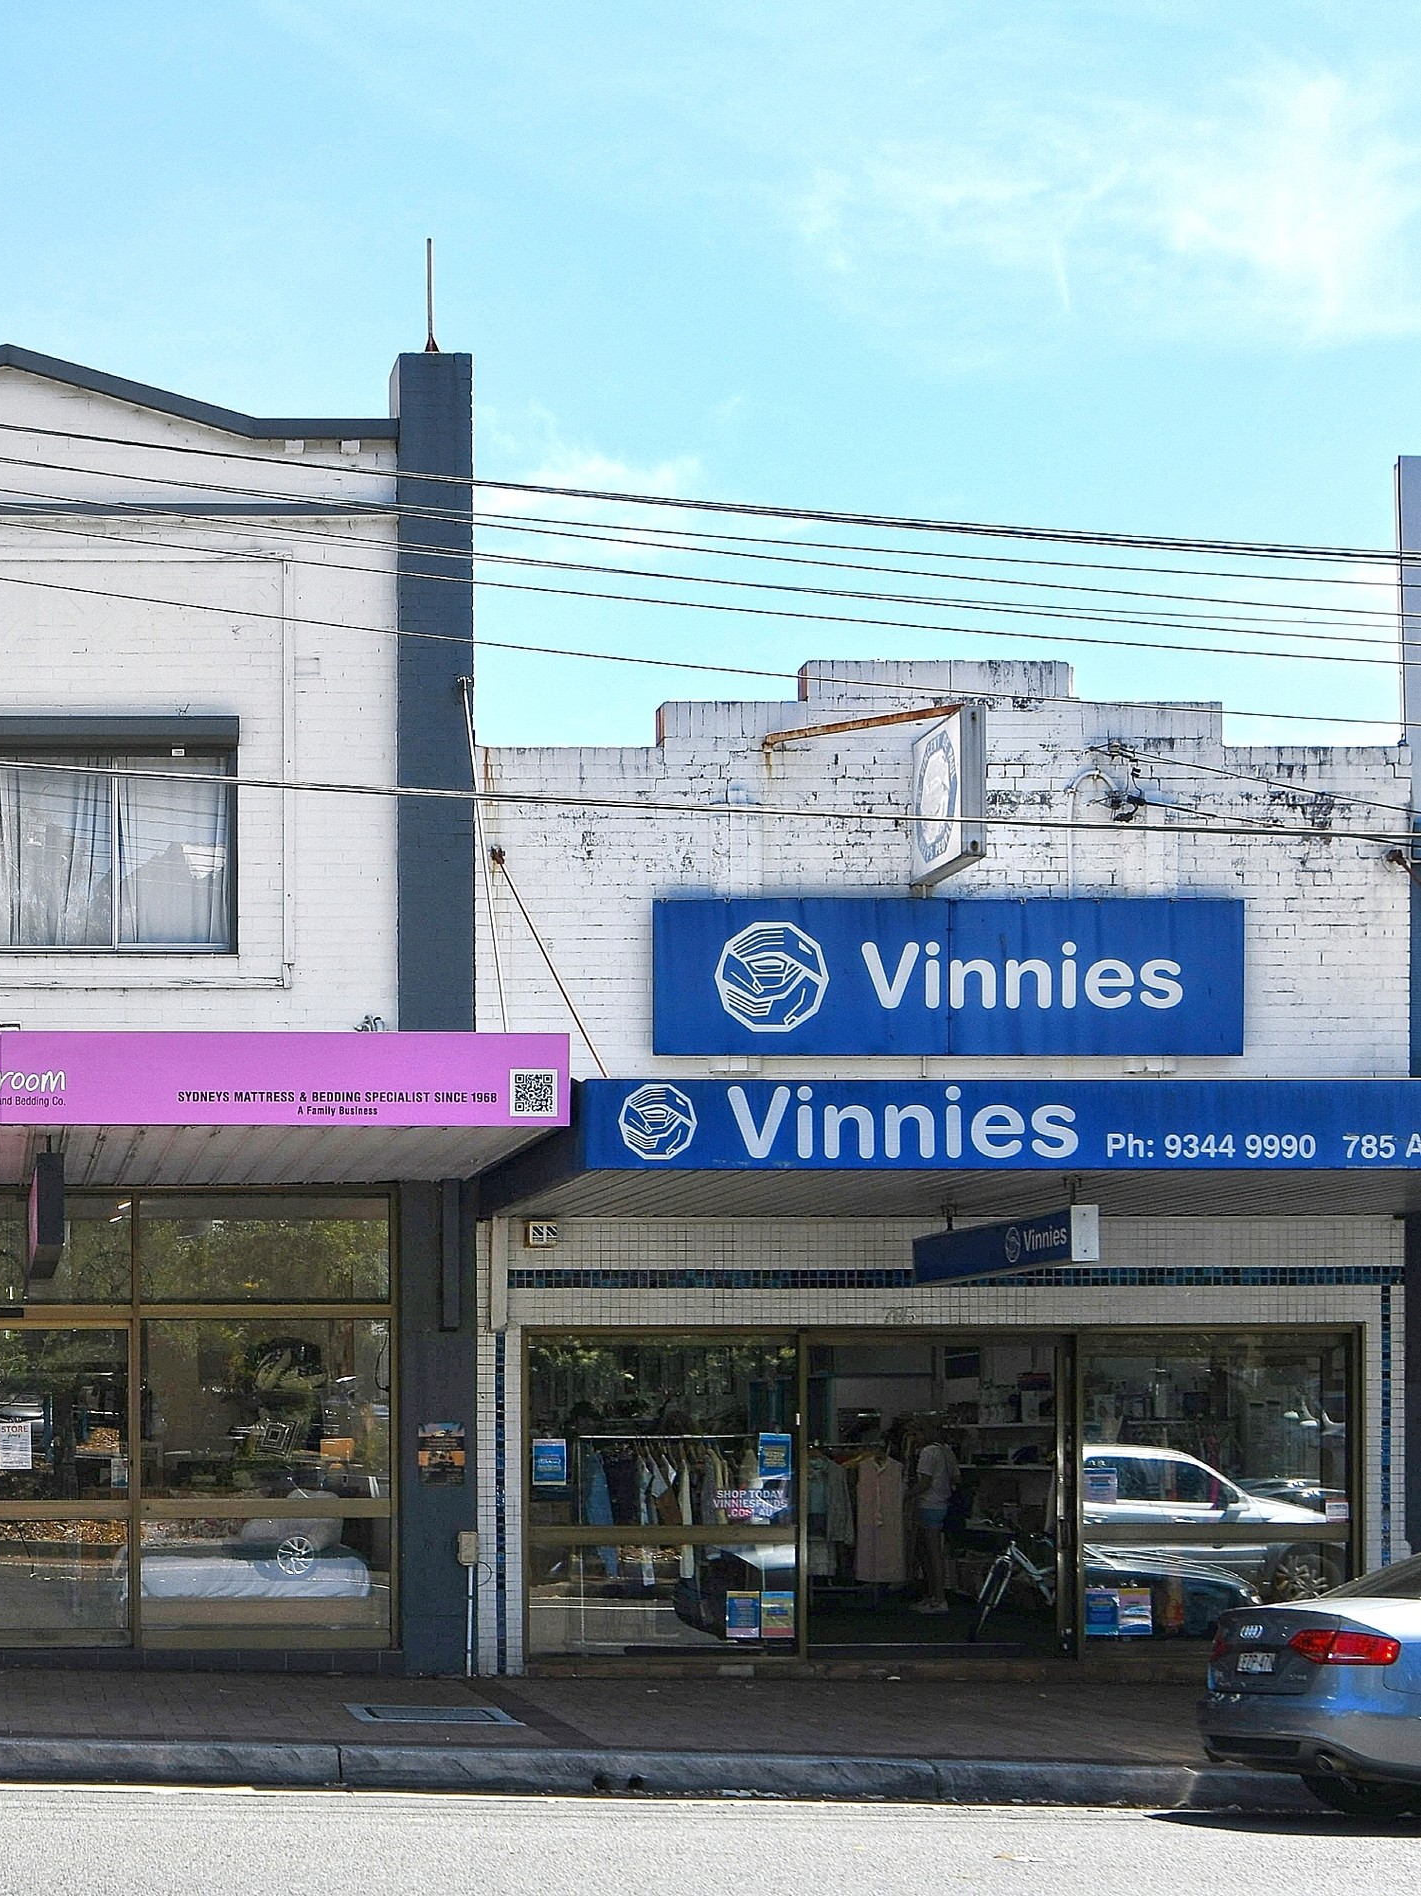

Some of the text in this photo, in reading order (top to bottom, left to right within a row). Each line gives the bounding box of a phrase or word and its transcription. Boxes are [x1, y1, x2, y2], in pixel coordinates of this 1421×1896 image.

[861, 941, 1184, 1009] Vinnies
[14, 1095, 50, 1108] Bedding
[52, 1095, 67, 1106] Co.
[177, 1091, 498, 1103] SYDNEYS MATTRESS & BEDDING SPECIALIST SINCE 1968
[297, 1105, 379, 1117] A Family Business
[727, 1085, 1079, 1159] Vinnies
[1106, 1133, 1155, 1158] Ph:
[1164, 1133, 1236, 1159] 9344
[1244, 1133, 1317, 1159] 9990
[1342, 1133, 1397, 1159] 785
[1022, 1225, 1068, 1252] Vinnies
[1, 1425, 29, 1433] STORE
[716, 1489, 784, 1499] SHOP TODAY
